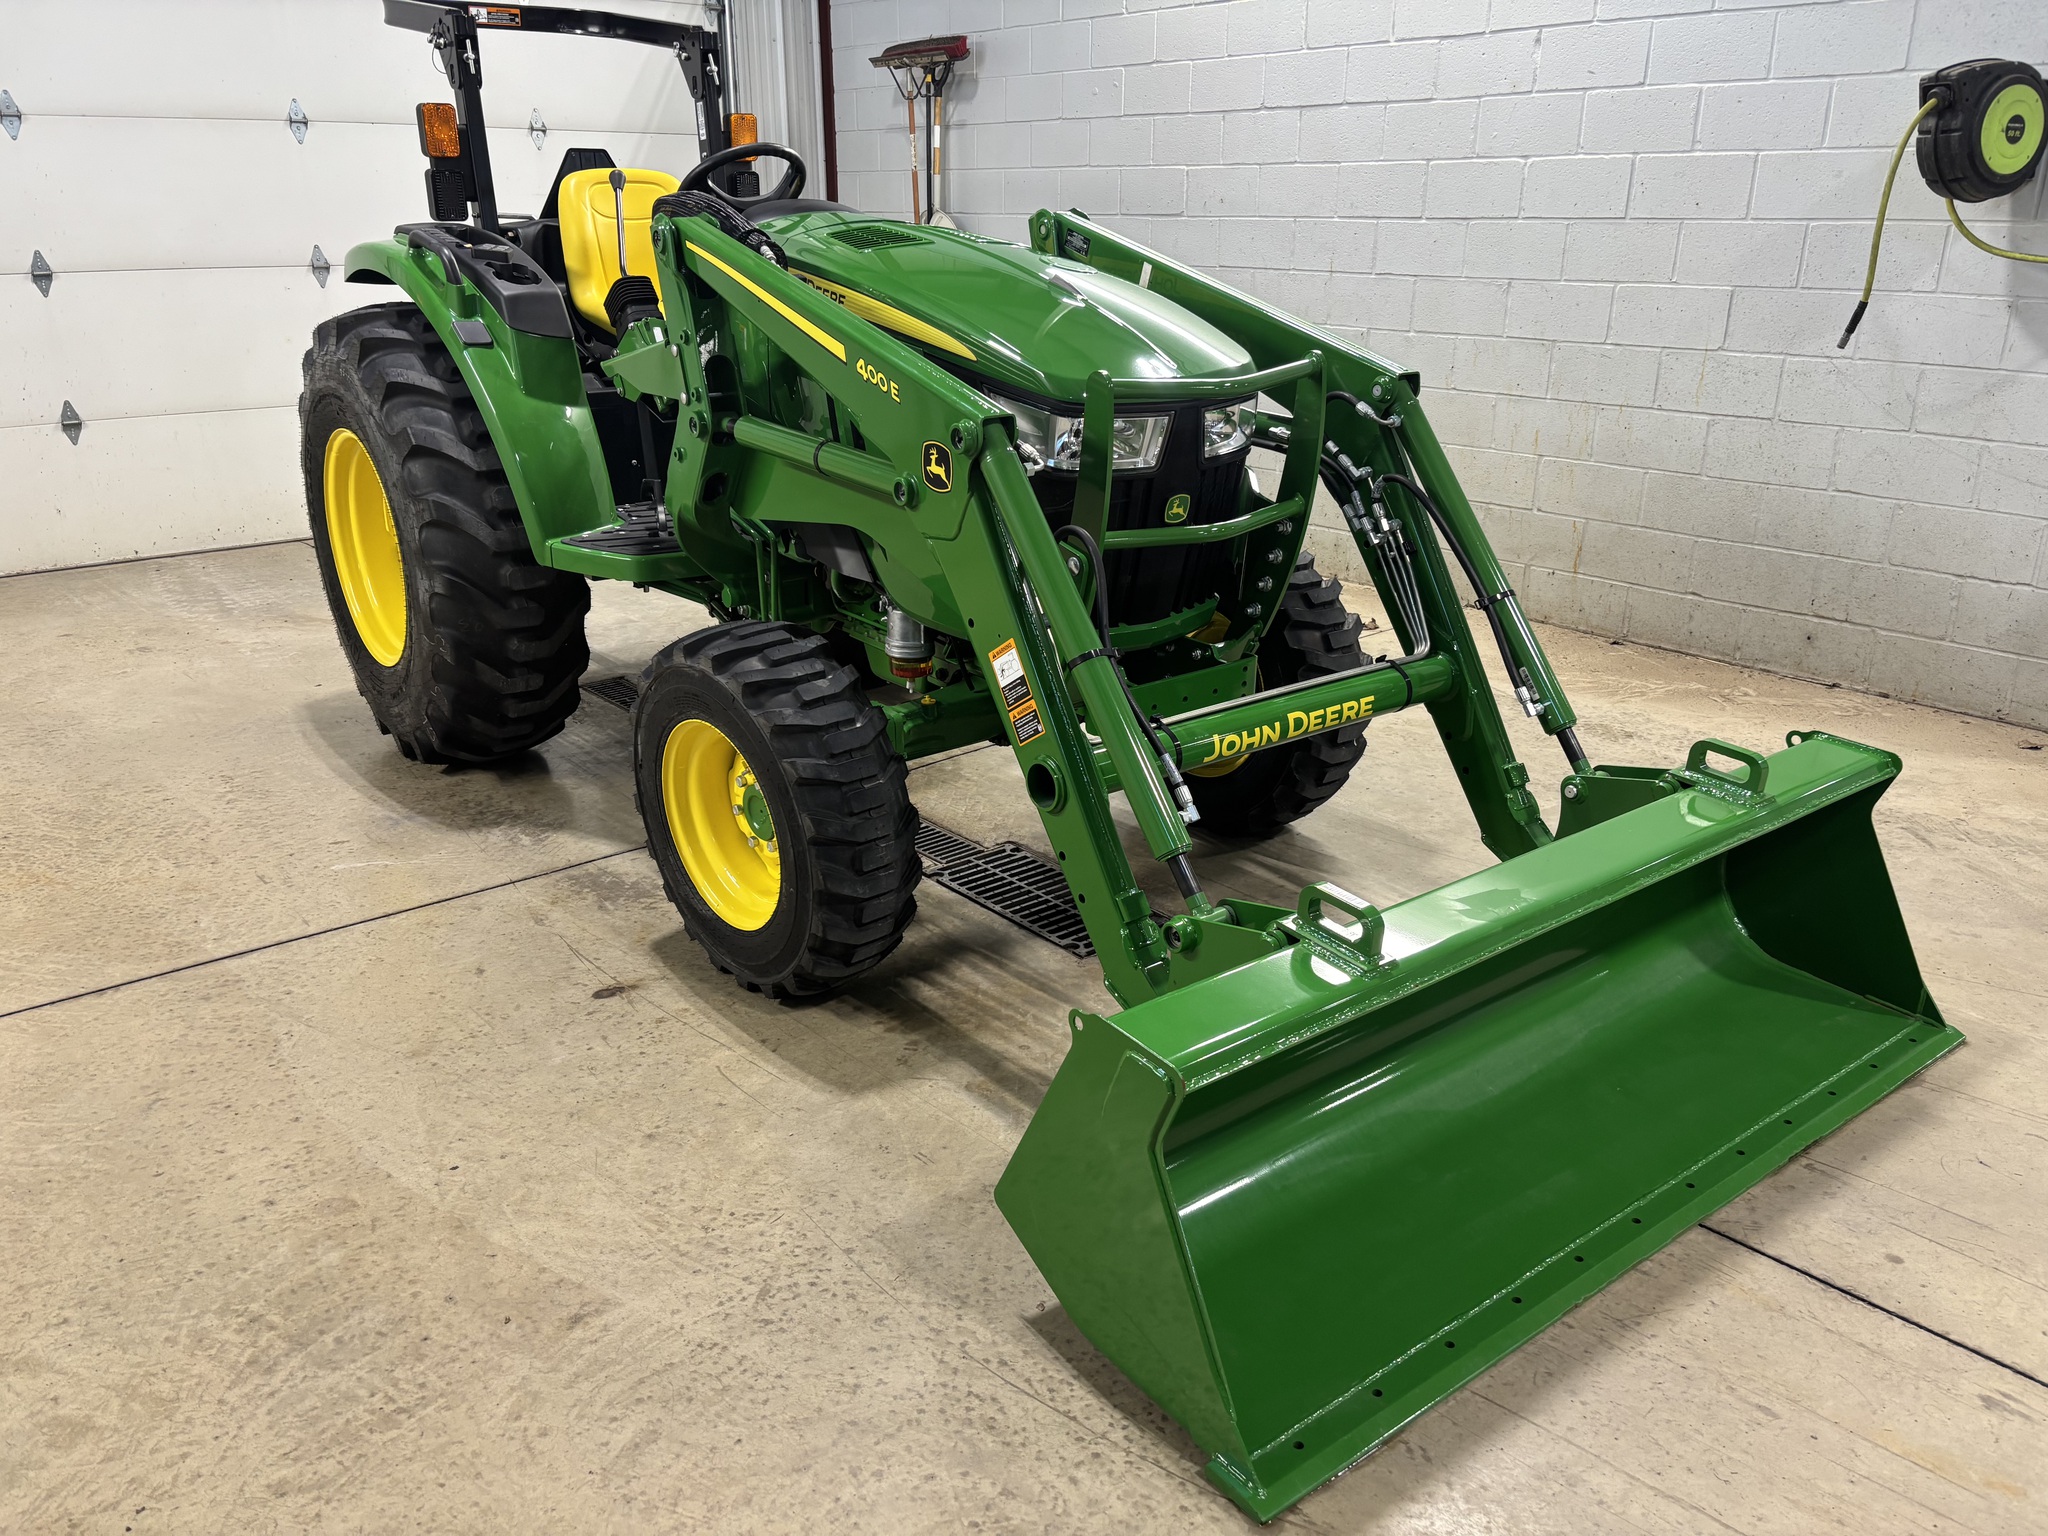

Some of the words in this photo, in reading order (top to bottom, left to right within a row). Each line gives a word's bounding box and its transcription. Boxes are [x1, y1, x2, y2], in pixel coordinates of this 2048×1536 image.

[996, 642, 1013, 655] WARNING
[1017, 703, 1034, 716] WARNING
[1203, 721, 1280, 763] JOHN
[1287, 695, 1375, 739] DEERE
